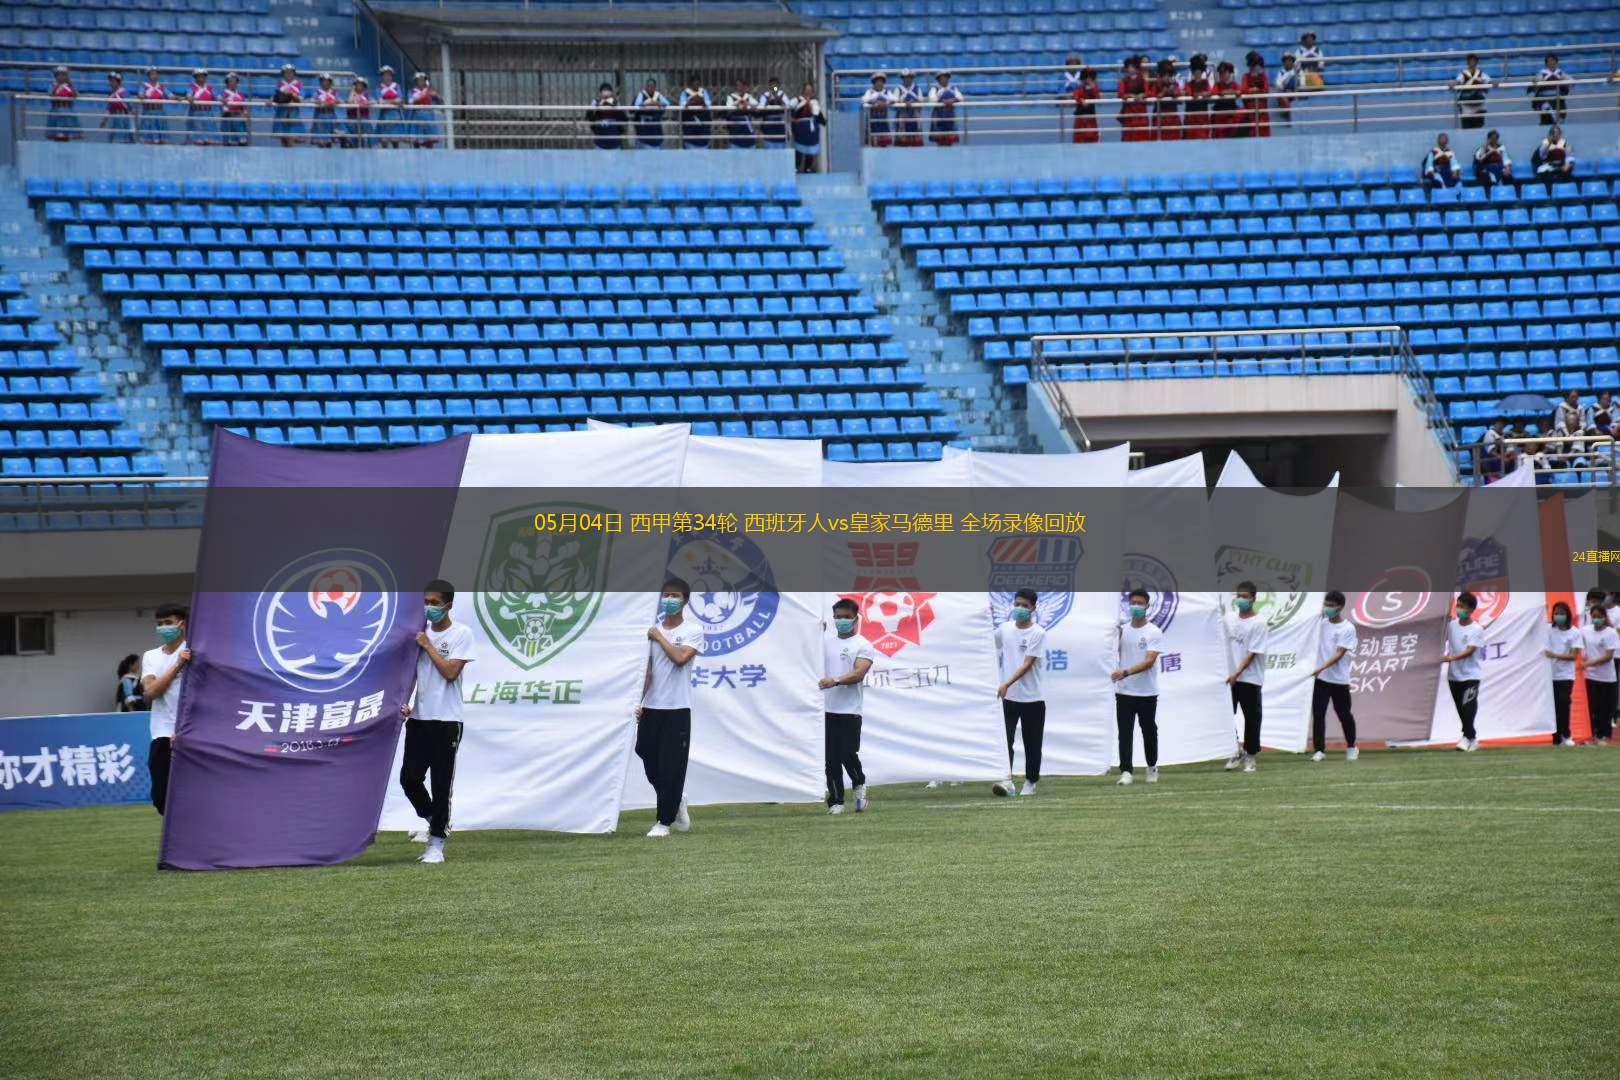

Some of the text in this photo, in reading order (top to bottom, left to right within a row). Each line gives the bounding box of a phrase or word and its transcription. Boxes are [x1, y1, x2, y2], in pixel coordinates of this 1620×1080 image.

[848, 542, 920, 567] 359
[1382, 589, 1403, 612] S
[1346, 632, 1419, 657] 动星空
[462, 680, 584, 705] 上海华正
[1348, 676, 1393, 693] SKY
[235, 690, 385, 733] 天津富晟
